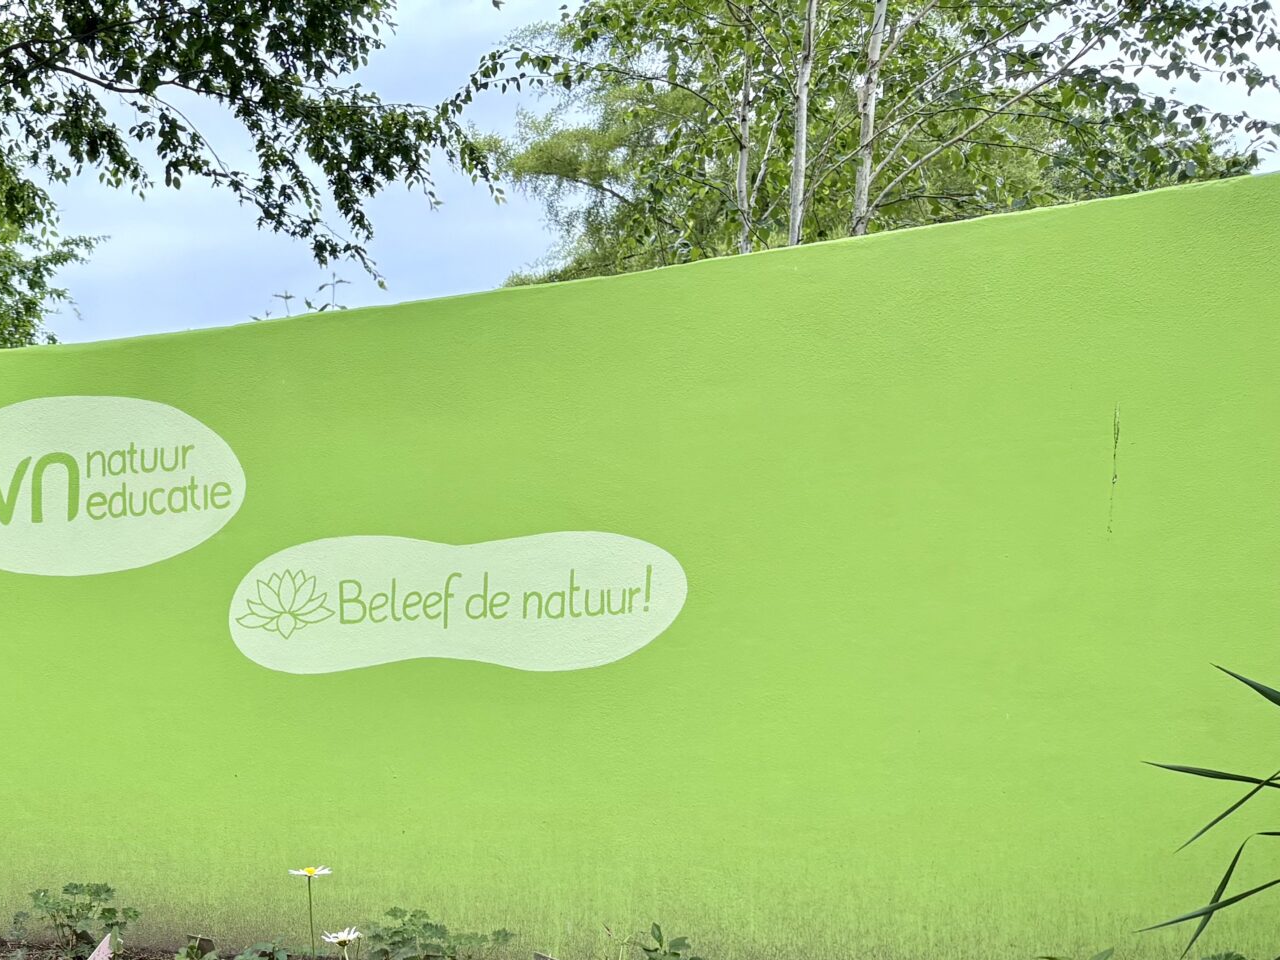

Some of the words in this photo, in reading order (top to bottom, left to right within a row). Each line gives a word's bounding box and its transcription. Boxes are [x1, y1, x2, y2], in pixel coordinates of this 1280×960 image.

[86, 442, 195, 478] natuur
[85, 476, 232, 520] educatie
[338, 572, 462, 629] Beleef
[465, 571, 510, 620] de
[522, 564, 653, 619] natuur!
